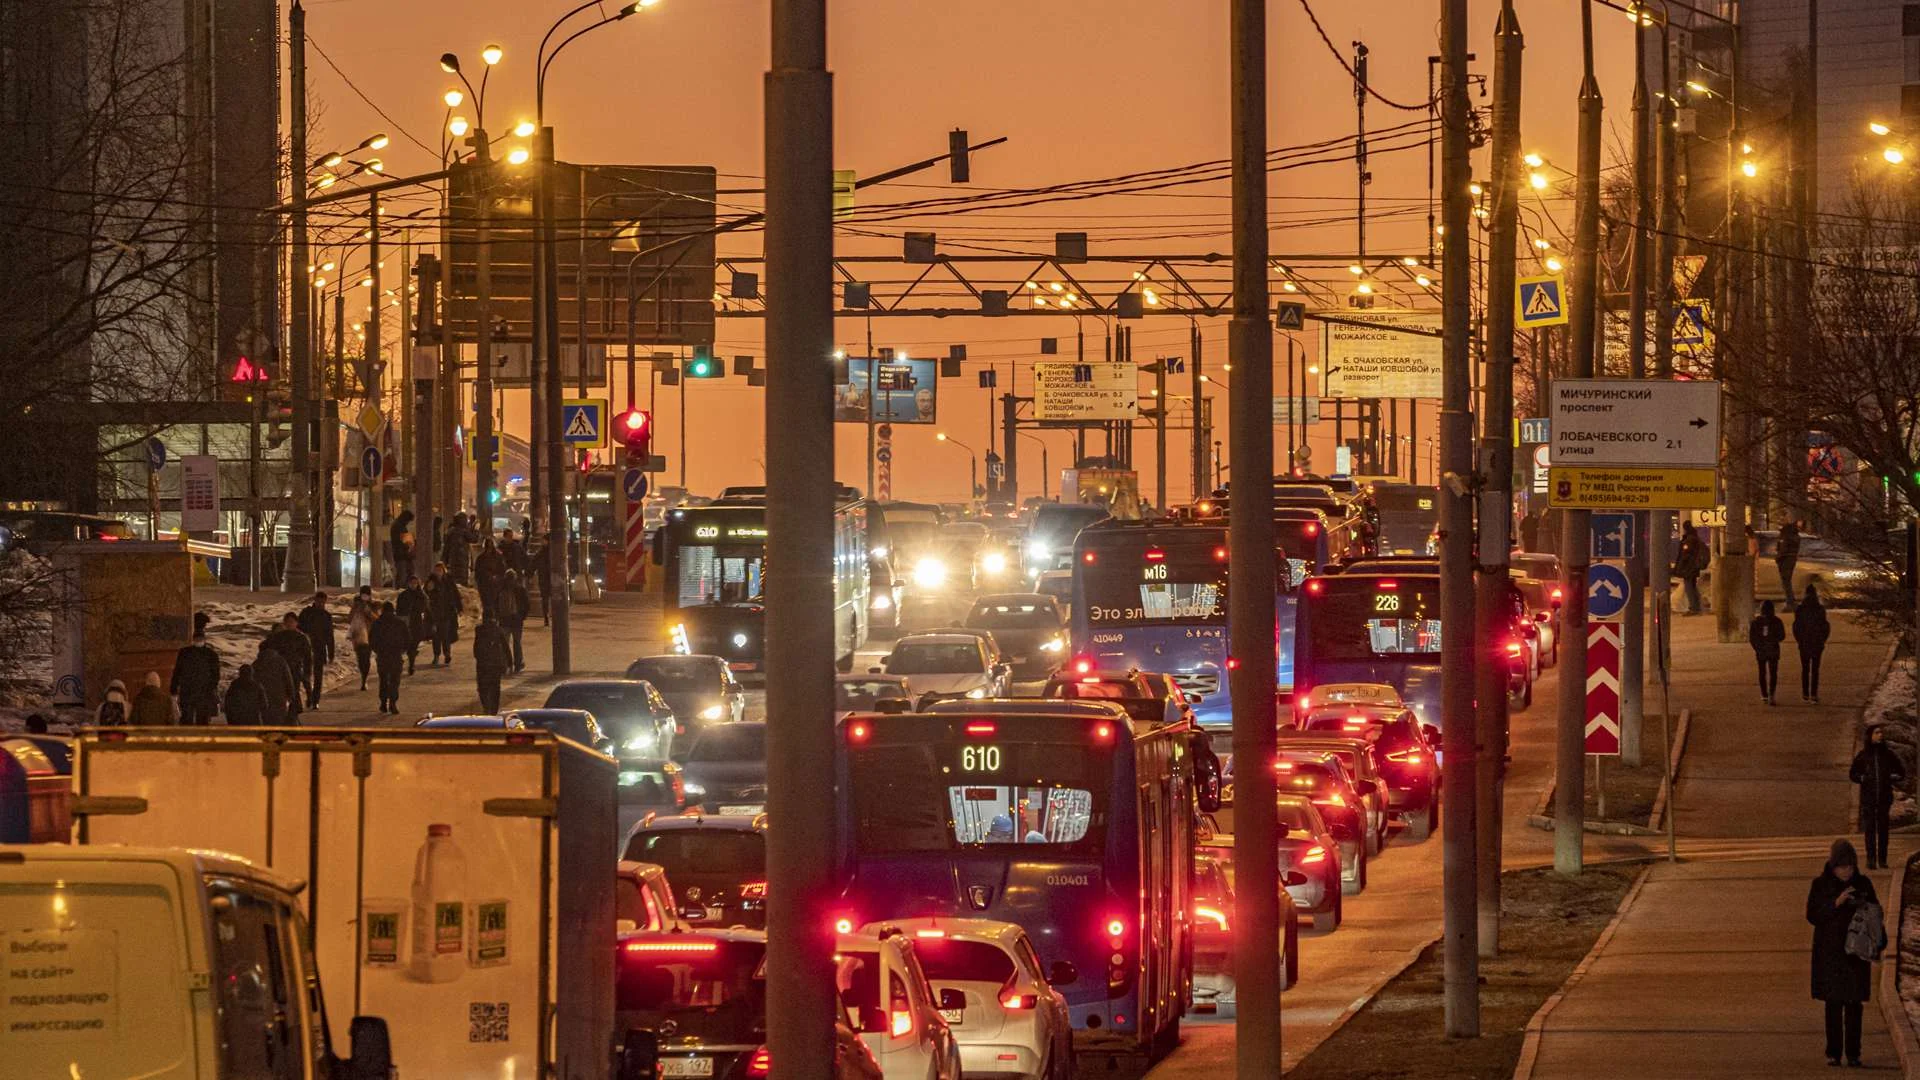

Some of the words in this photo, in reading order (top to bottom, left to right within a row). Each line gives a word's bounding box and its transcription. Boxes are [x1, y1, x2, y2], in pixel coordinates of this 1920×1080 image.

[1334, 332, 1388, 341] МОЖАЙСКОЕ
[1353, 356, 1411, 364] ОЧАКОВСКАЯ
[1380, 364, 1429, 373] КОВШОВОЙ
[1560, 388, 1652, 400] МИЧУРИНСКИЙ
[1560, 403, 1614, 413] проспект
[1559, 431, 1658, 442] ЛОБАЧЕВСКОГО
[1665, 439, 1683, 449] 2.1
[1559, 446, 1595, 457] улица
[1580, 472, 1621, 481] Телефон
[1623, 474, 1664, 483] доверия
[1593, 483, 1615, 493] МВД
[1616, 484, 1651, 493] России
[1653, 485, 1667, 493] по
[1144, 564, 1167, 580] м16
[1375, 595, 1399, 611] 226
[1090, 605, 1121, 621] Это
[1093, 633, 1124, 643] 410449
[963, 746, 1000, 771] 610
[1047, 875, 1089, 886] 010401
[10, 940, 68, 954] Выбери
